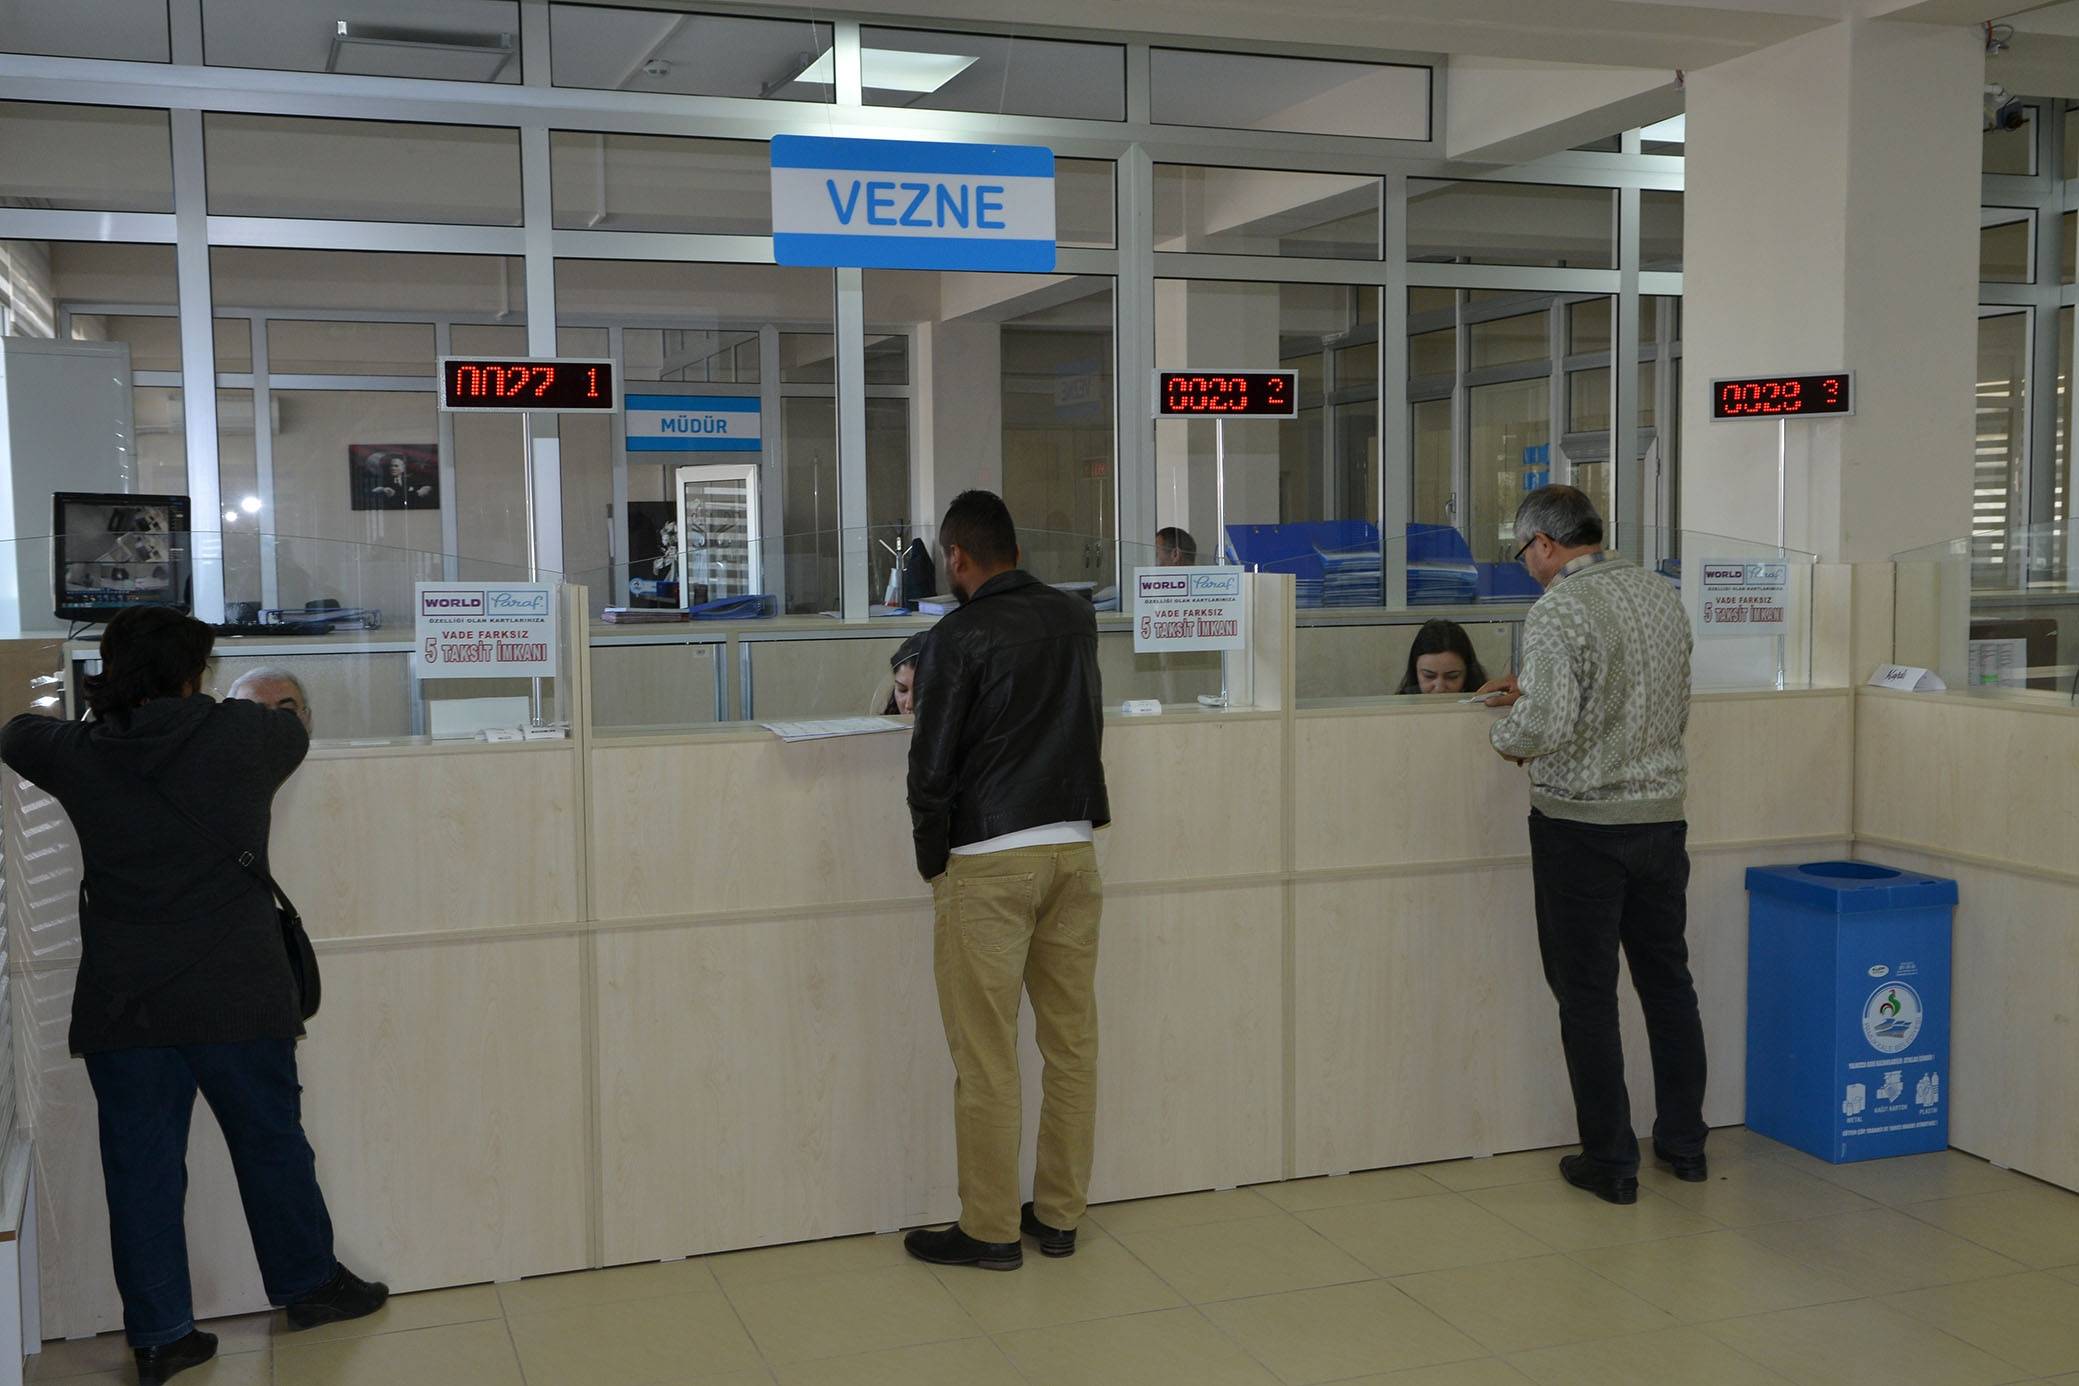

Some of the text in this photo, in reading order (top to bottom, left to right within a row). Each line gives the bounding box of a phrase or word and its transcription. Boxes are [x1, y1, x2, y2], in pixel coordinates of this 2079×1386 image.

[826, 179, 1006, 229] VEZNE
[587, 368, 599, 397] 1
[1267, 378, 1284, 404] 2
[1822, 379, 1839, 403] 3
[661, 414, 728, 434] MÜDÜR
[1142, 581, 1186, 590] WORLD
[425, 598, 482, 607] WORLD
[1155, 608, 1223, 617] VADE FARKSIZ
[1704, 601, 1713, 623] 5
[442, 630, 529, 639] VADE FARKSIZ
[1141, 616, 1238, 639] 5 TAKSİT İMKANI
[425, 637, 548, 663] 5 TAKSİT İMKANI
